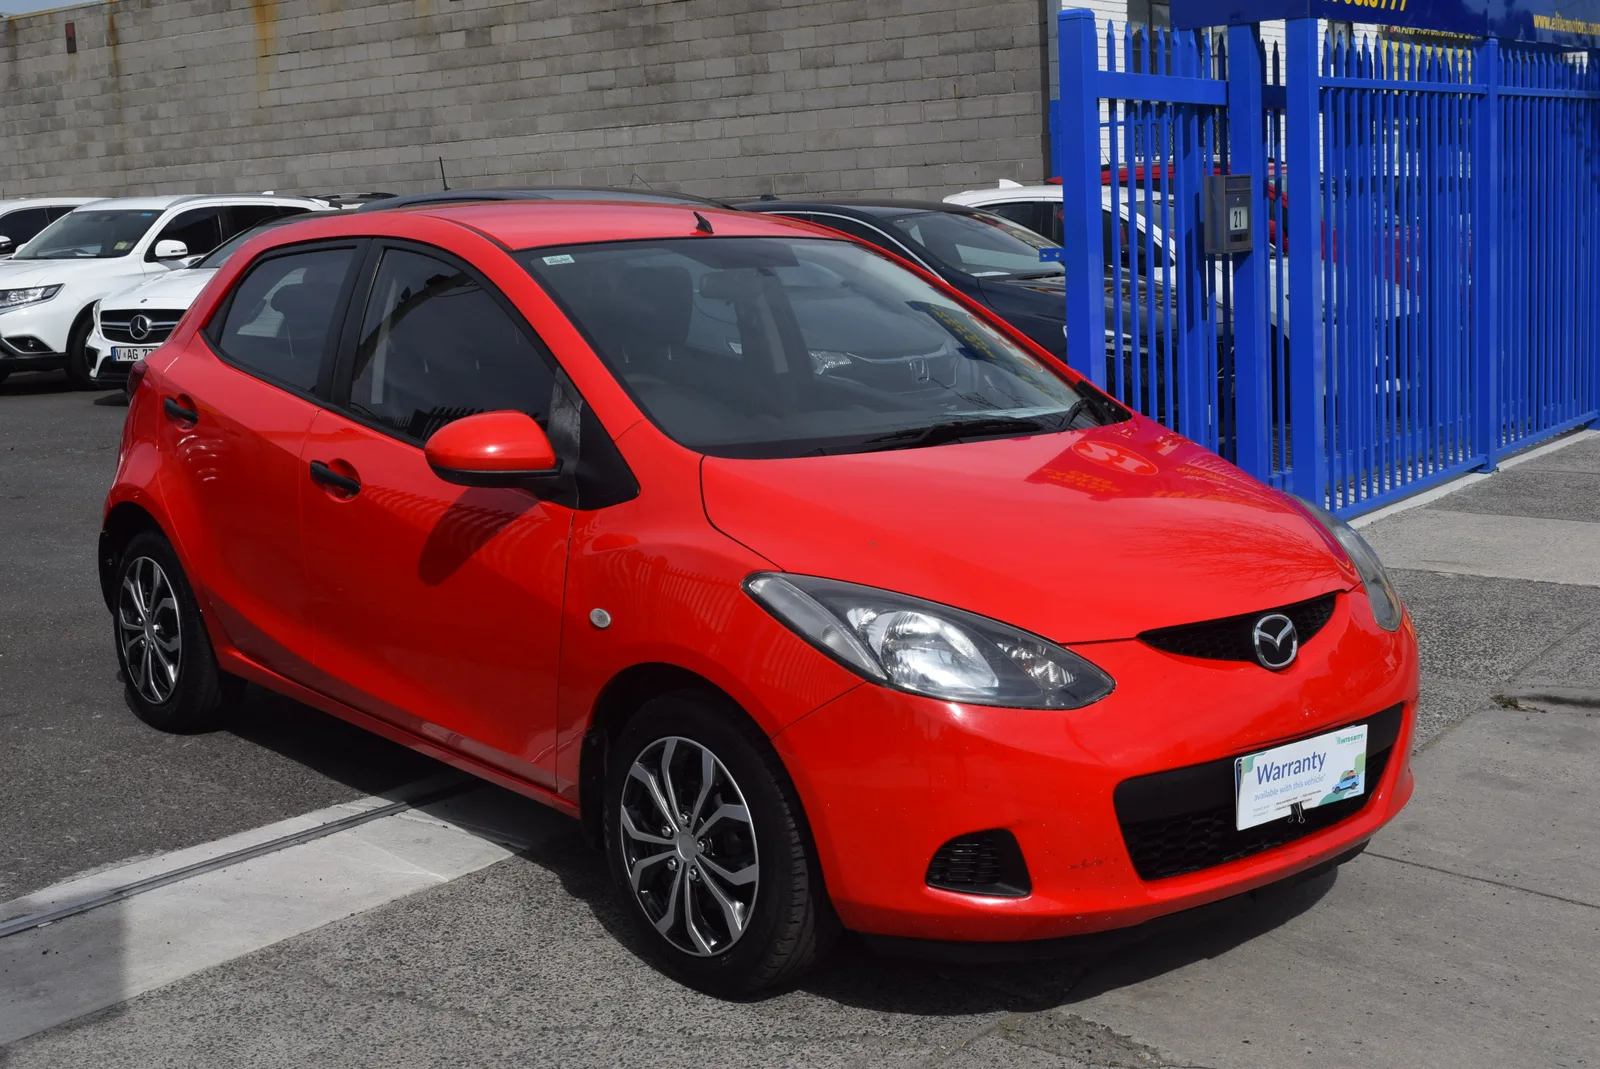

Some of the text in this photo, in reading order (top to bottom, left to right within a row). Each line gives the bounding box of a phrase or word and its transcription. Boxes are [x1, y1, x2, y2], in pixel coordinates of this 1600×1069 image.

[1233, 210, 1242, 228] 21
[1256, 751, 1327, 785] Warranty
[1253, 787, 1279, 801] available
[1279, 783, 1293, 794] with
[1293, 779, 1304, 790] this
